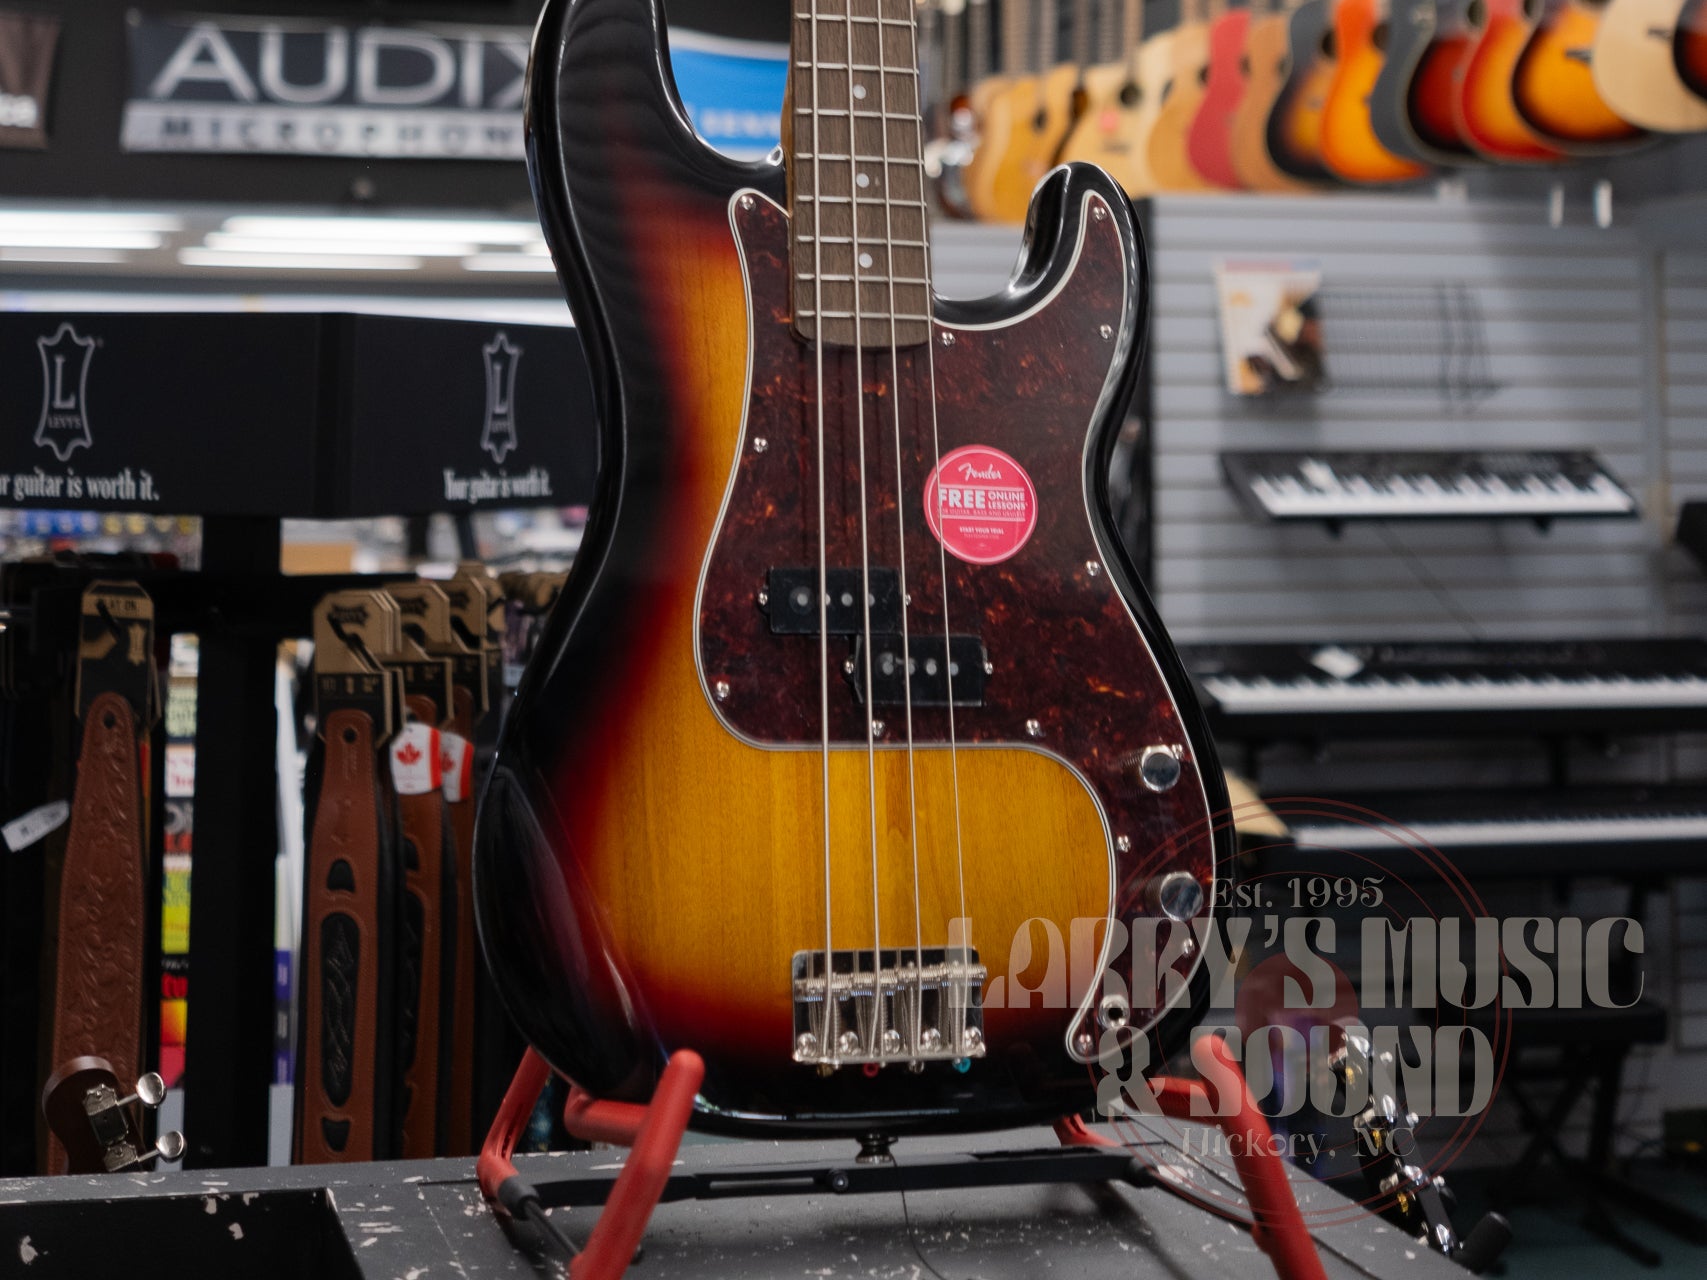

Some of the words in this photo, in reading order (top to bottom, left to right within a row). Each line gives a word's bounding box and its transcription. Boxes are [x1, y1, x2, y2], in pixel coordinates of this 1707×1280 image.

[53, 355, 76, 409] L
[958, 463, 1002, 482] Fender
[13, 466, 63, 502] guitar
[66, 468, 83, 499] is
[86, 467, 136, 500] worth
[140, 469, 160, 502] it.
[939, 488, 986, 510] FREE
[987, 491, 1025, 503] ONLINE
